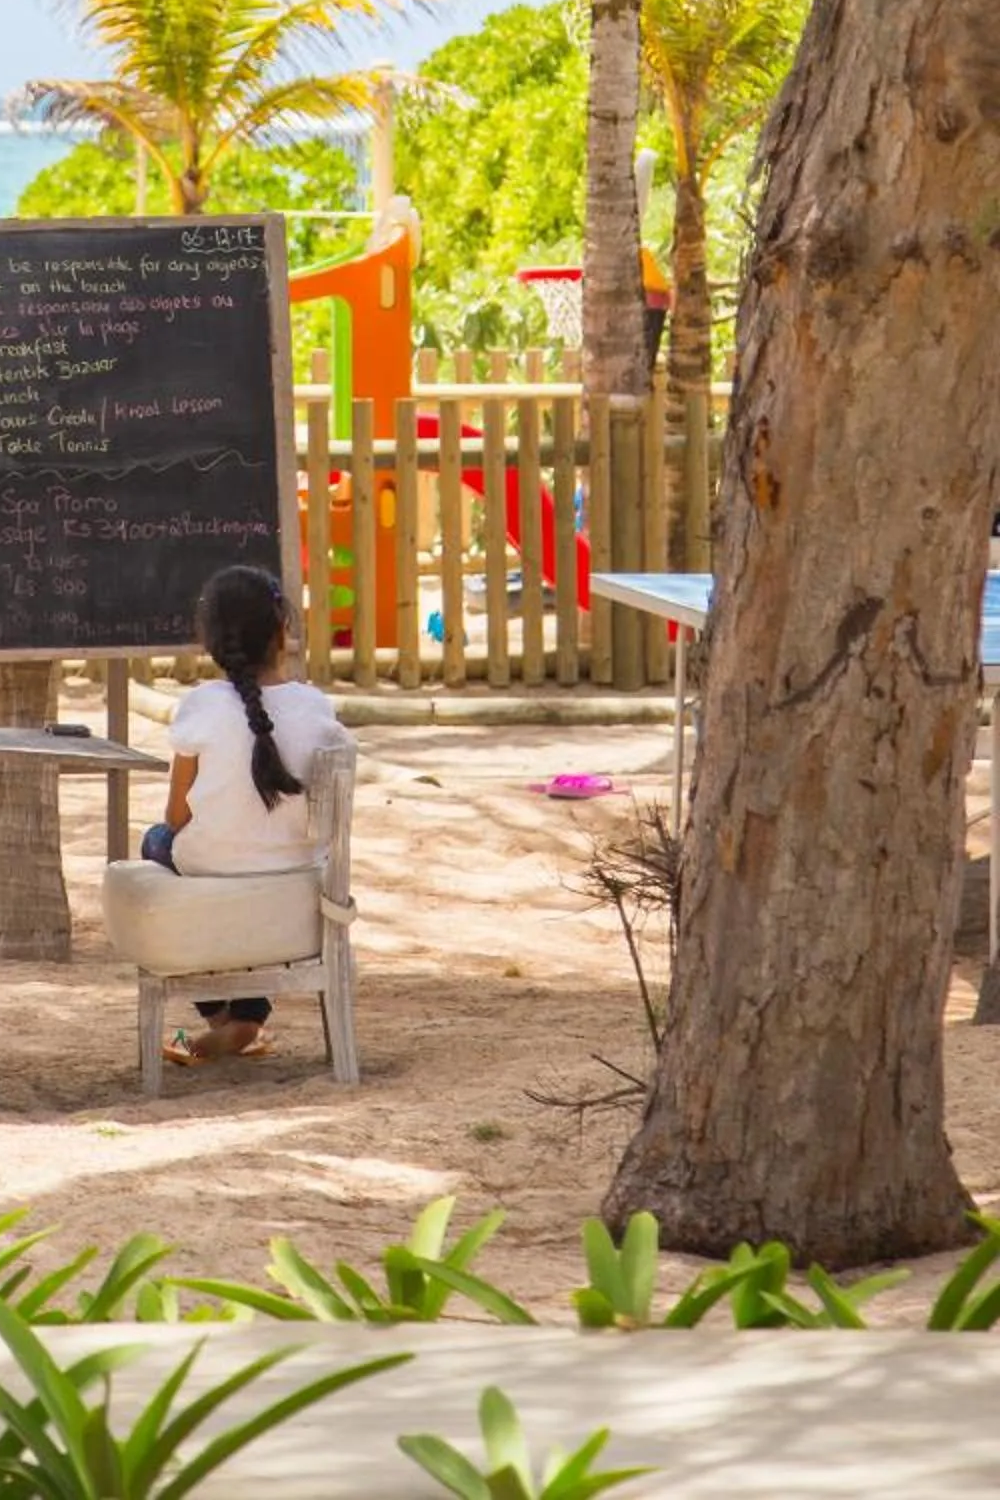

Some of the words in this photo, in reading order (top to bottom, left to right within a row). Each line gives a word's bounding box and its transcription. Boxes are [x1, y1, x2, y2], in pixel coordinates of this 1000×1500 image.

[7, 256, 33, 273] be
[45, 255, 132, 281] responsible
[139, 253, 160, 280] for
[168, 260, 201, 281] any
[20, 283, 40, 295] on
[48, 279, 73, 293] the
[81, 278, 127, 293] beach
[212, 295, 233, 309] ou
[79, 319, 95, 337] la
[56, 357, 118, 379] Bazaar
[49, 430, 112, 453] Tennis
[0, 487, 41, 528] Spa
[46, 485, 118, 513] Promo
